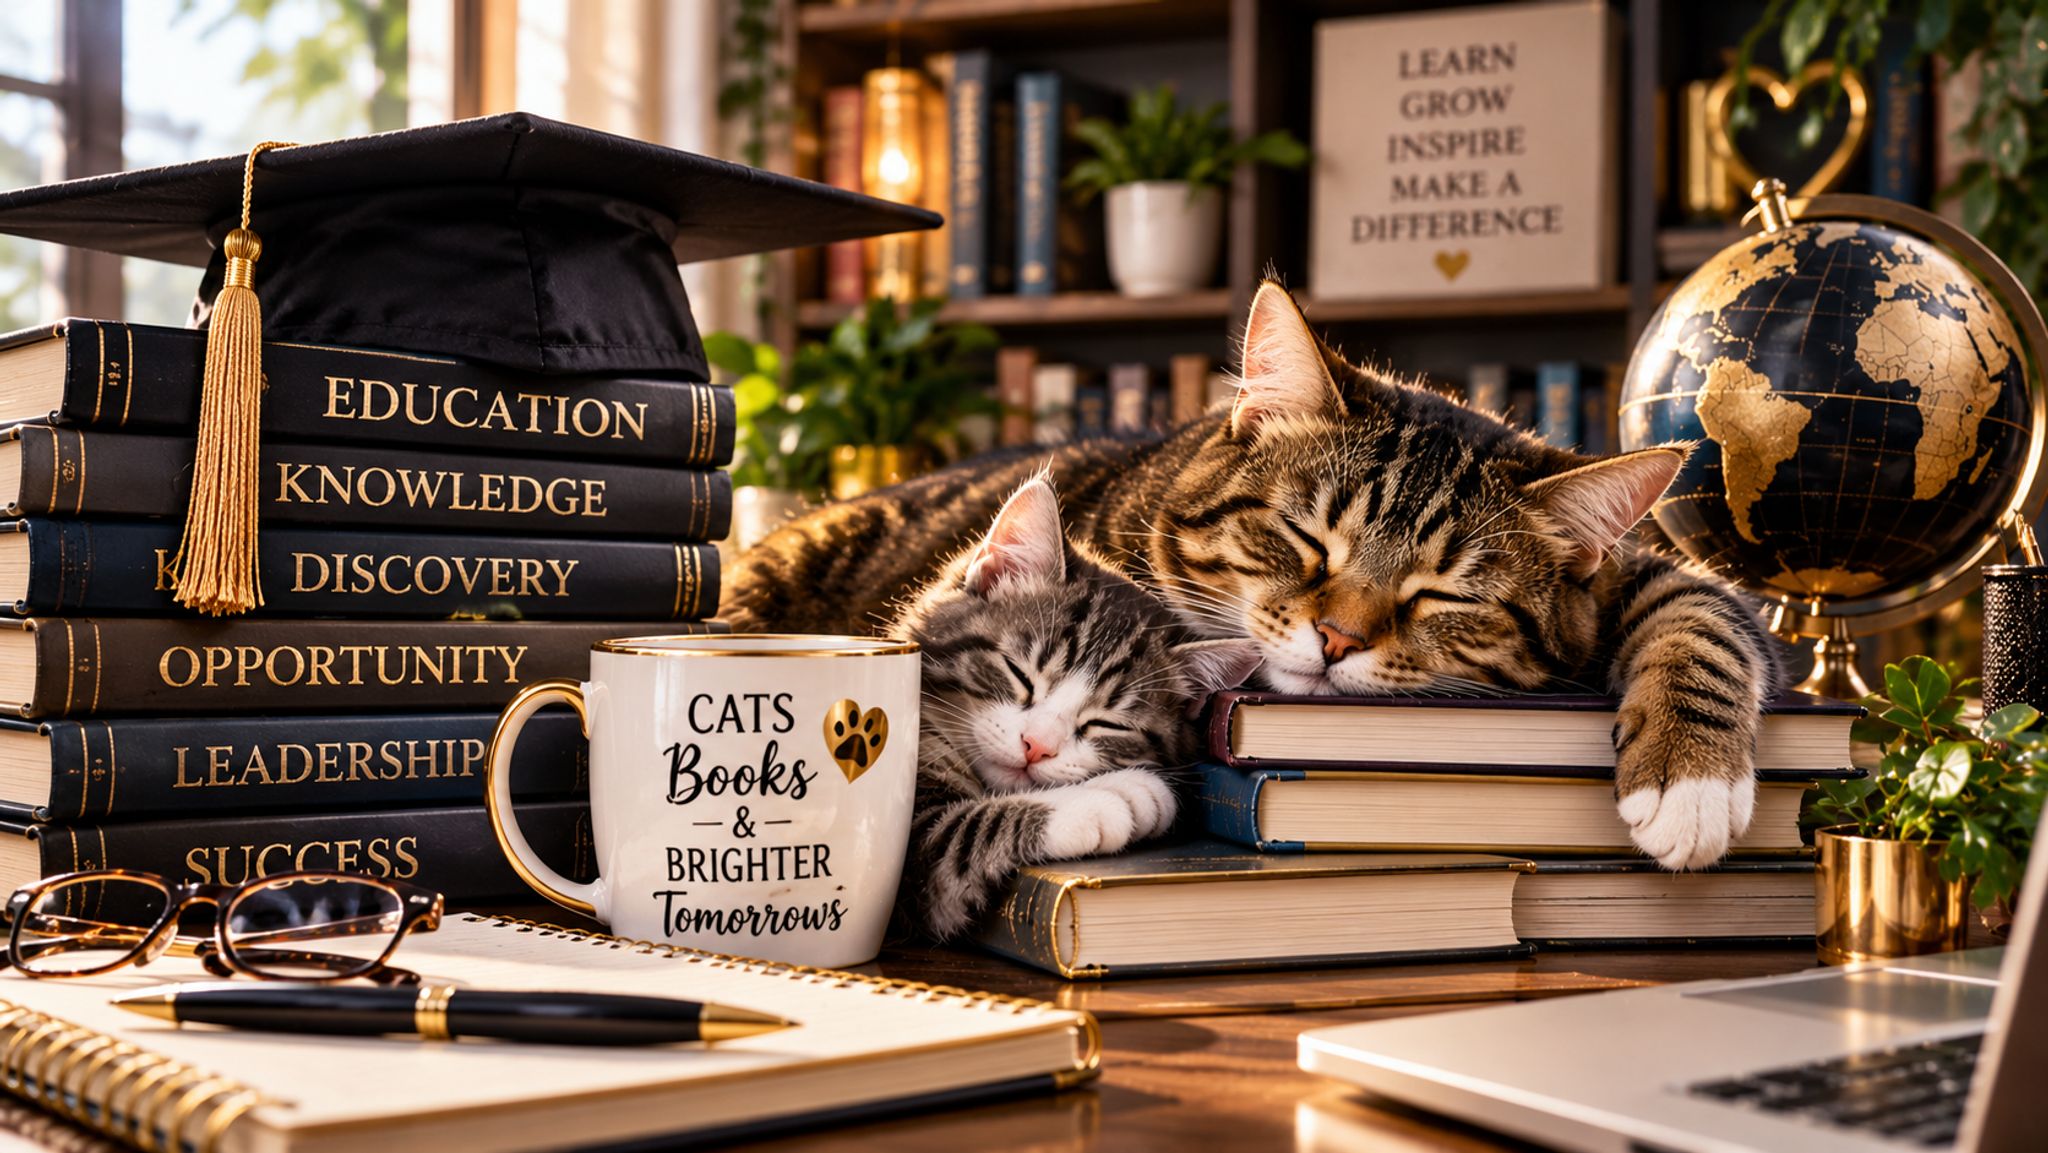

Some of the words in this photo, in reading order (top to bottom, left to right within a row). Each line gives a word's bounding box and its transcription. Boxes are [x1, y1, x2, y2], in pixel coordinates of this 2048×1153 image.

[1399, 42, 1517, 80] LEARN
[1401, 85, 1514, 120] GROW
[1388, 126, 1526, 163] INSPIRE
[1390, 171, 1489, 203] MAKE
[1498, 169, 1522, 196] A
[1351, 204, 1564, 243] DIFFERENCE
[322, 375, 648, 440] EDUCATION
[275, 462, 608, 518] KNOWLEDGE
[291, 552, 580, 597] DISCOVERY
[158, 645, 529, 689] OPPORTUNITY
[688, 693, 795, 734] CATS
[172, 738, 485, 788] LEADERSHIP
[663, 740, 818, 805] Books
[732, 805, 756, 839] &
[183, 836, 419, 890] SUCCESS
[665, 843, 832, 883] BRIGHTER
[652, 890, 848, 937] Tomorrows
